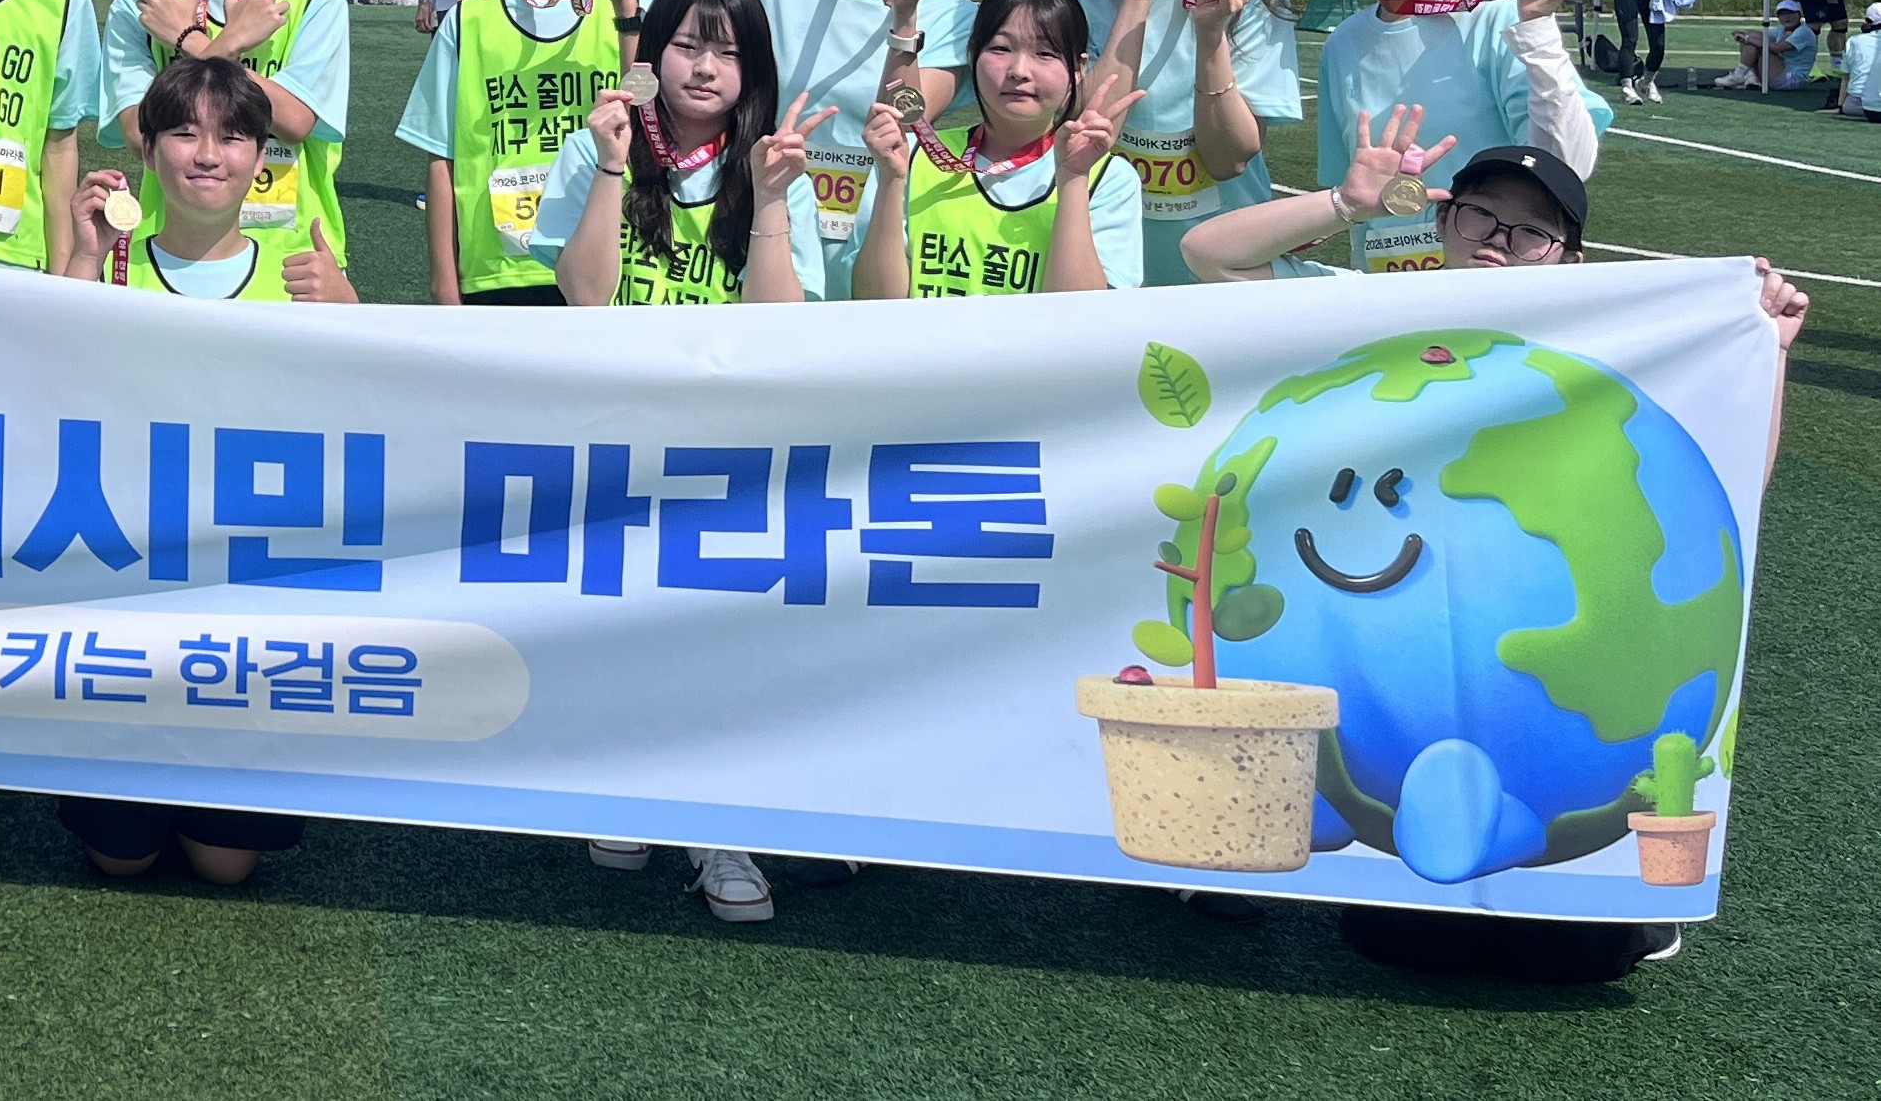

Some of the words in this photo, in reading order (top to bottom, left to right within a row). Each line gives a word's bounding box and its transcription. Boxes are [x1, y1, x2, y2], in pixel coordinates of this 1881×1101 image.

[1, 44, 35, 85] GO
[485, 73, 529, 115] 탄소
[536, 72, 582, 110] 줄이
[490, 118, 529, 157] 지구
[492, 176, 517, 188] 2026
[920, 232, 972, 280] 탄소
[981, 243, 1039, 294] 줄이
[459, 441, 1055, 609] 마라톤
[178, 632, 423, 716] 한걸음
